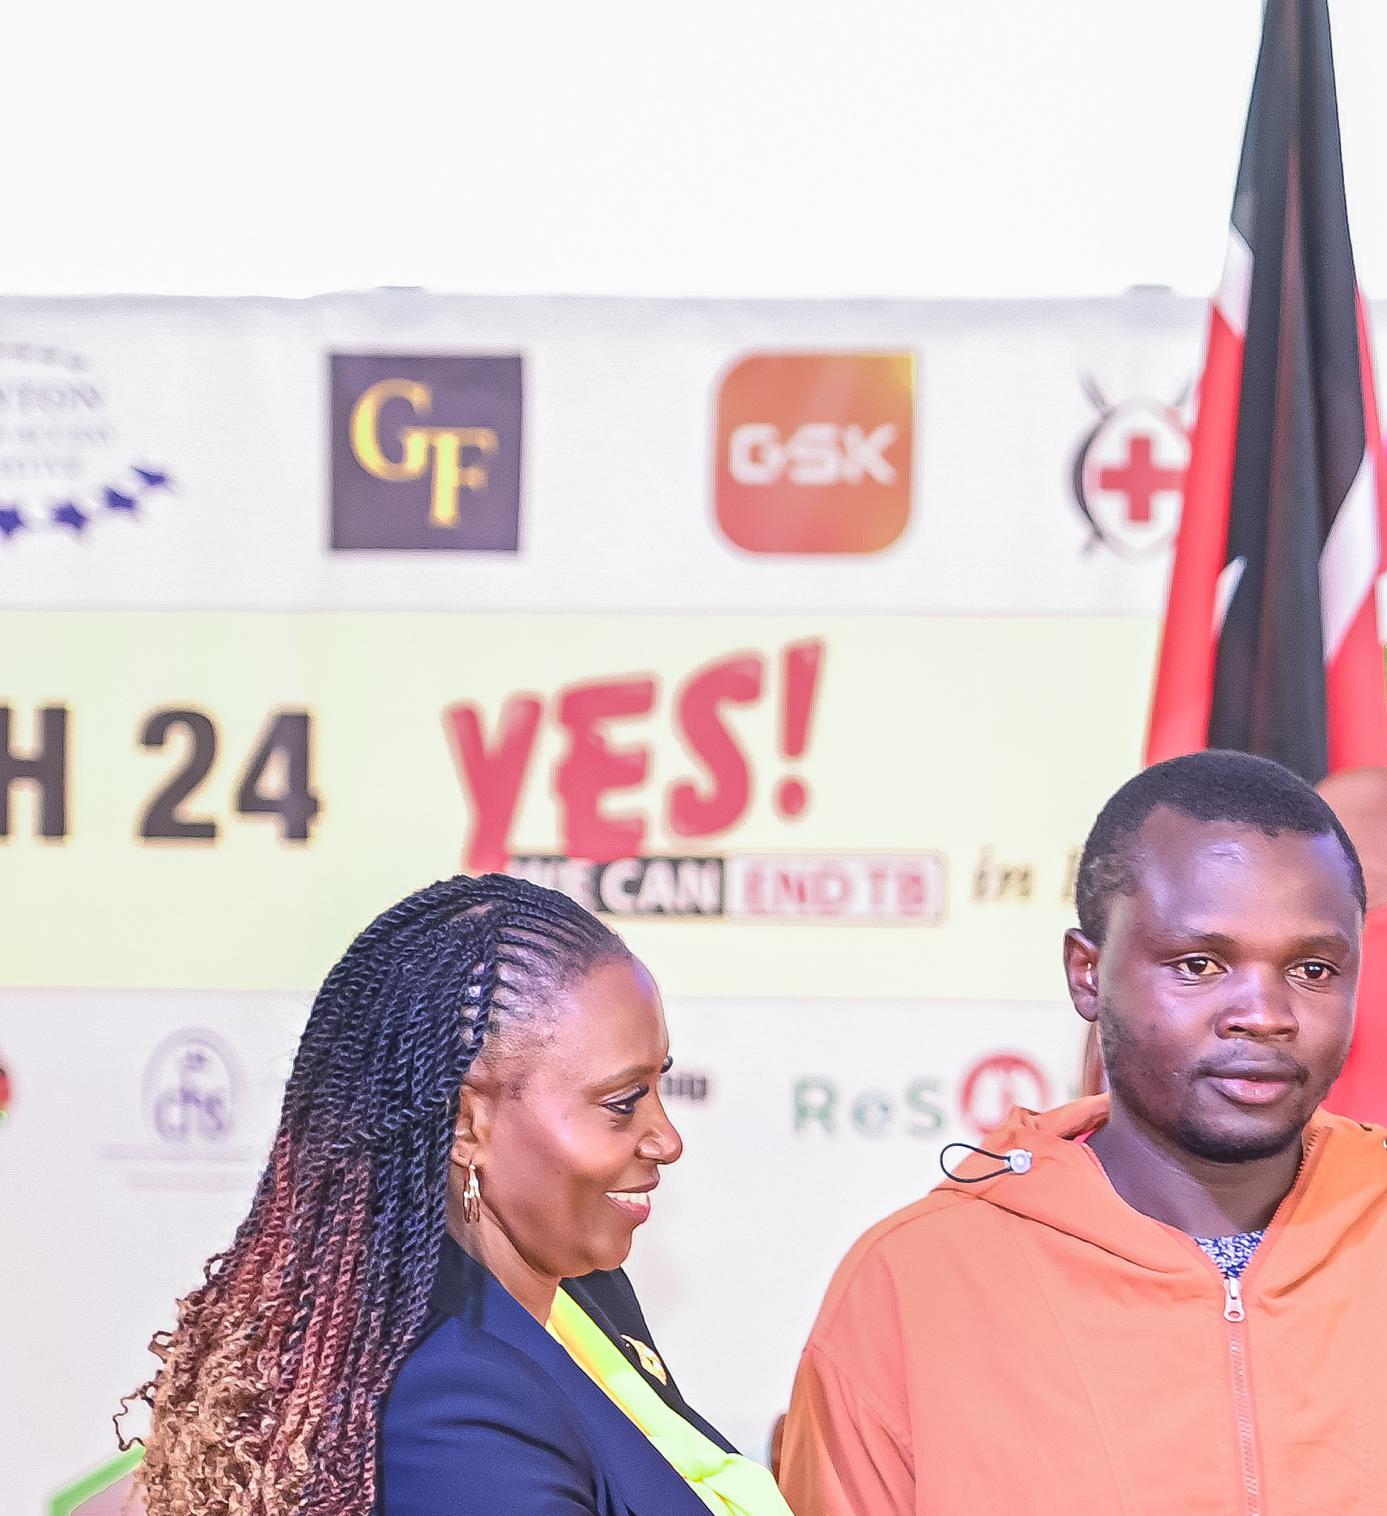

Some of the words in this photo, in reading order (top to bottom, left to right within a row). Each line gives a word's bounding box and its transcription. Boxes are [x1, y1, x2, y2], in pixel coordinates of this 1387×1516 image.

[349, 377, 500, 529] GF
[730, 422, 897, 486] GSK
[139, 708, 321, 842] 24
[444, 637, 826, 873] YES!
[602, 857, 724, 914] CAN
[743, 864, 858, 914] END
[868, 864, 929, 914] TB
